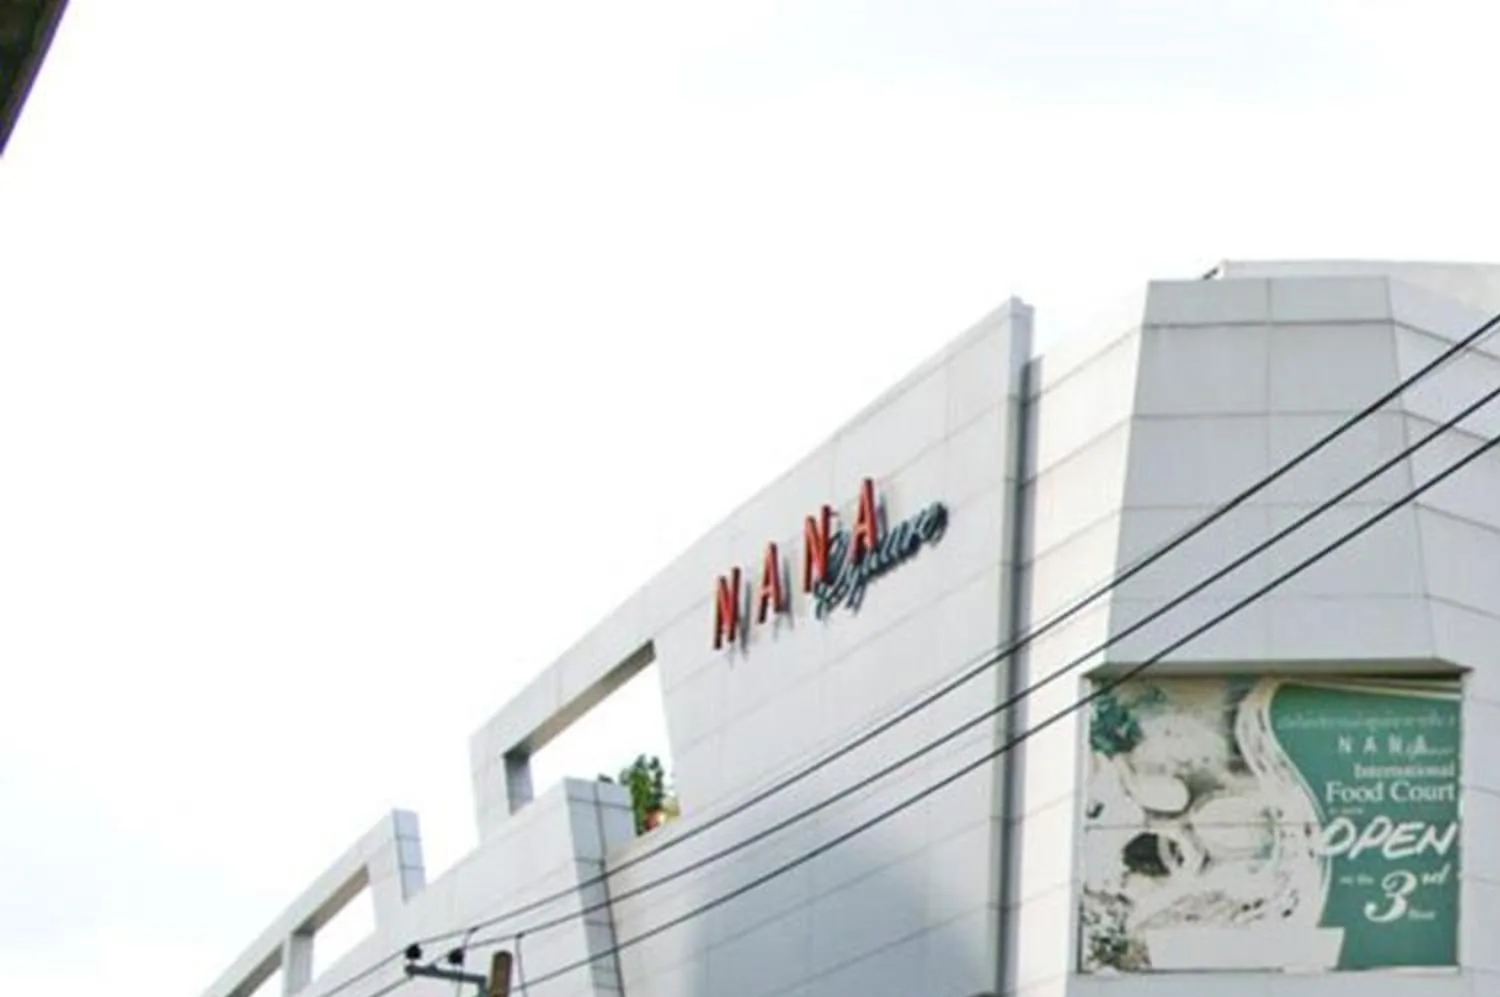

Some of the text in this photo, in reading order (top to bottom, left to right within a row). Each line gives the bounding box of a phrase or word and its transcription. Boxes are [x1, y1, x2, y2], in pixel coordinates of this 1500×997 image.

[712, 477, 879, 651] NANA
[1338, 733, 1428, 755] NANA
[1325, 779, 1455, 803] Food Court
[1318, 815, 1457, 860] OPEN
